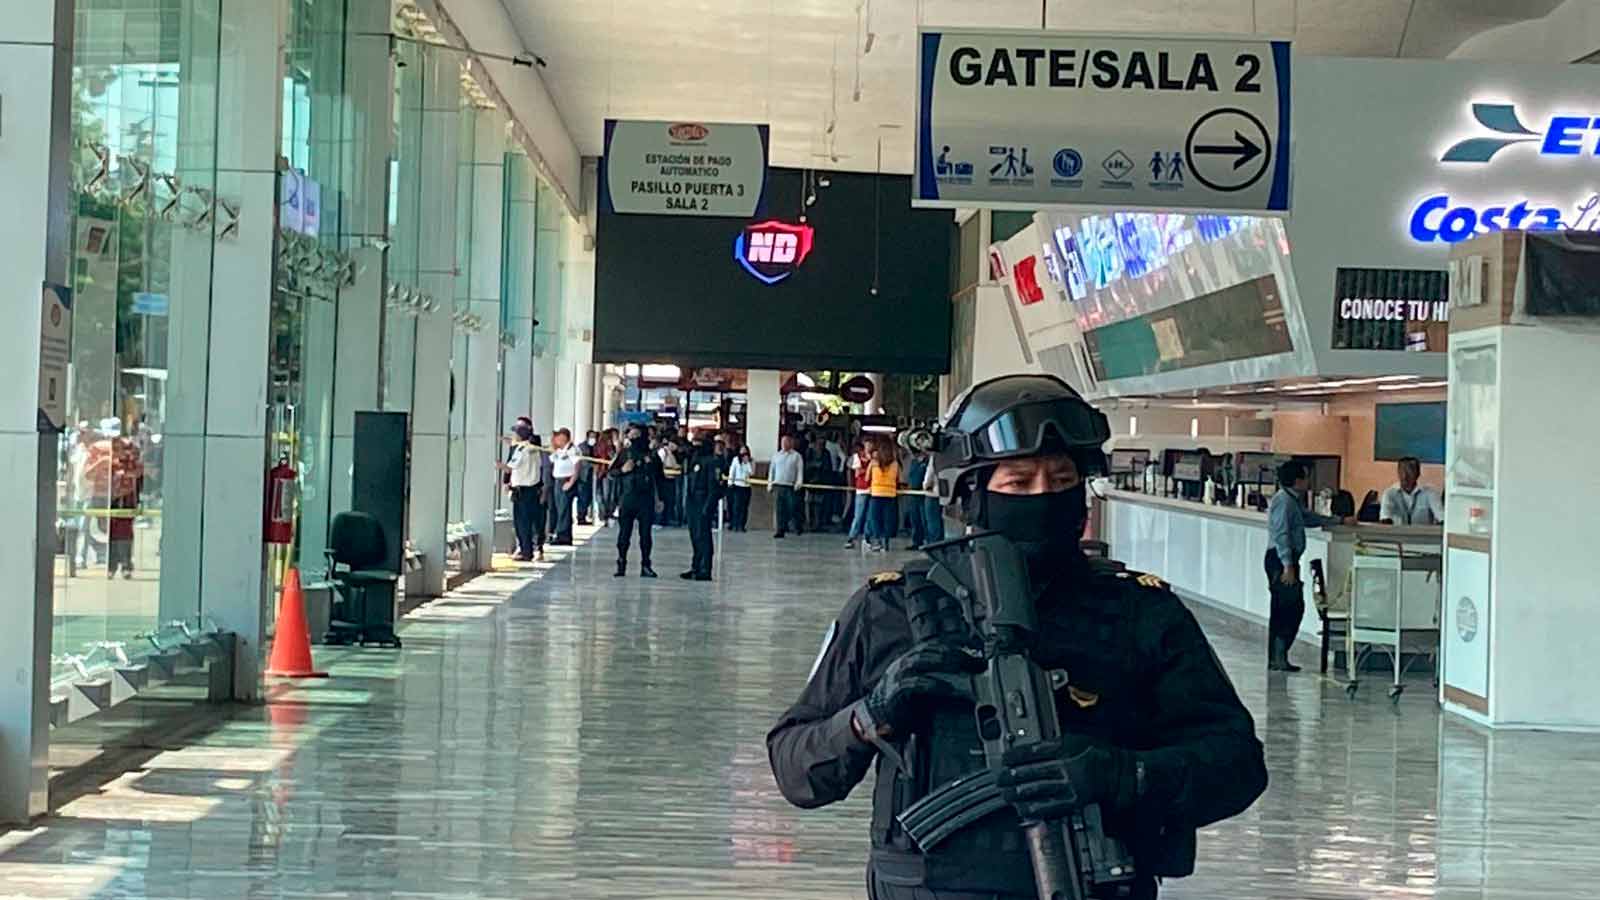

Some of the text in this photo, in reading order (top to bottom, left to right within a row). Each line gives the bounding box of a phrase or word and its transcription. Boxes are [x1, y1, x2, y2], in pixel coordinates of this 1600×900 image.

[949, 47, 1261, 93] GATE/SALA 2
[646, 154, 732, 166] ESTACIÓN DE PAGO
[631, 181, 744, 196] PASILLO PUERTA 3
[666, 197, 708, 210] SALA 2
[1410, 196, 1562, 242] Costa
[748, 232, 798, 263] ND
[1340, 298, 1404, 320] CONOCE
[1407, 300, 1429, 320] TU
